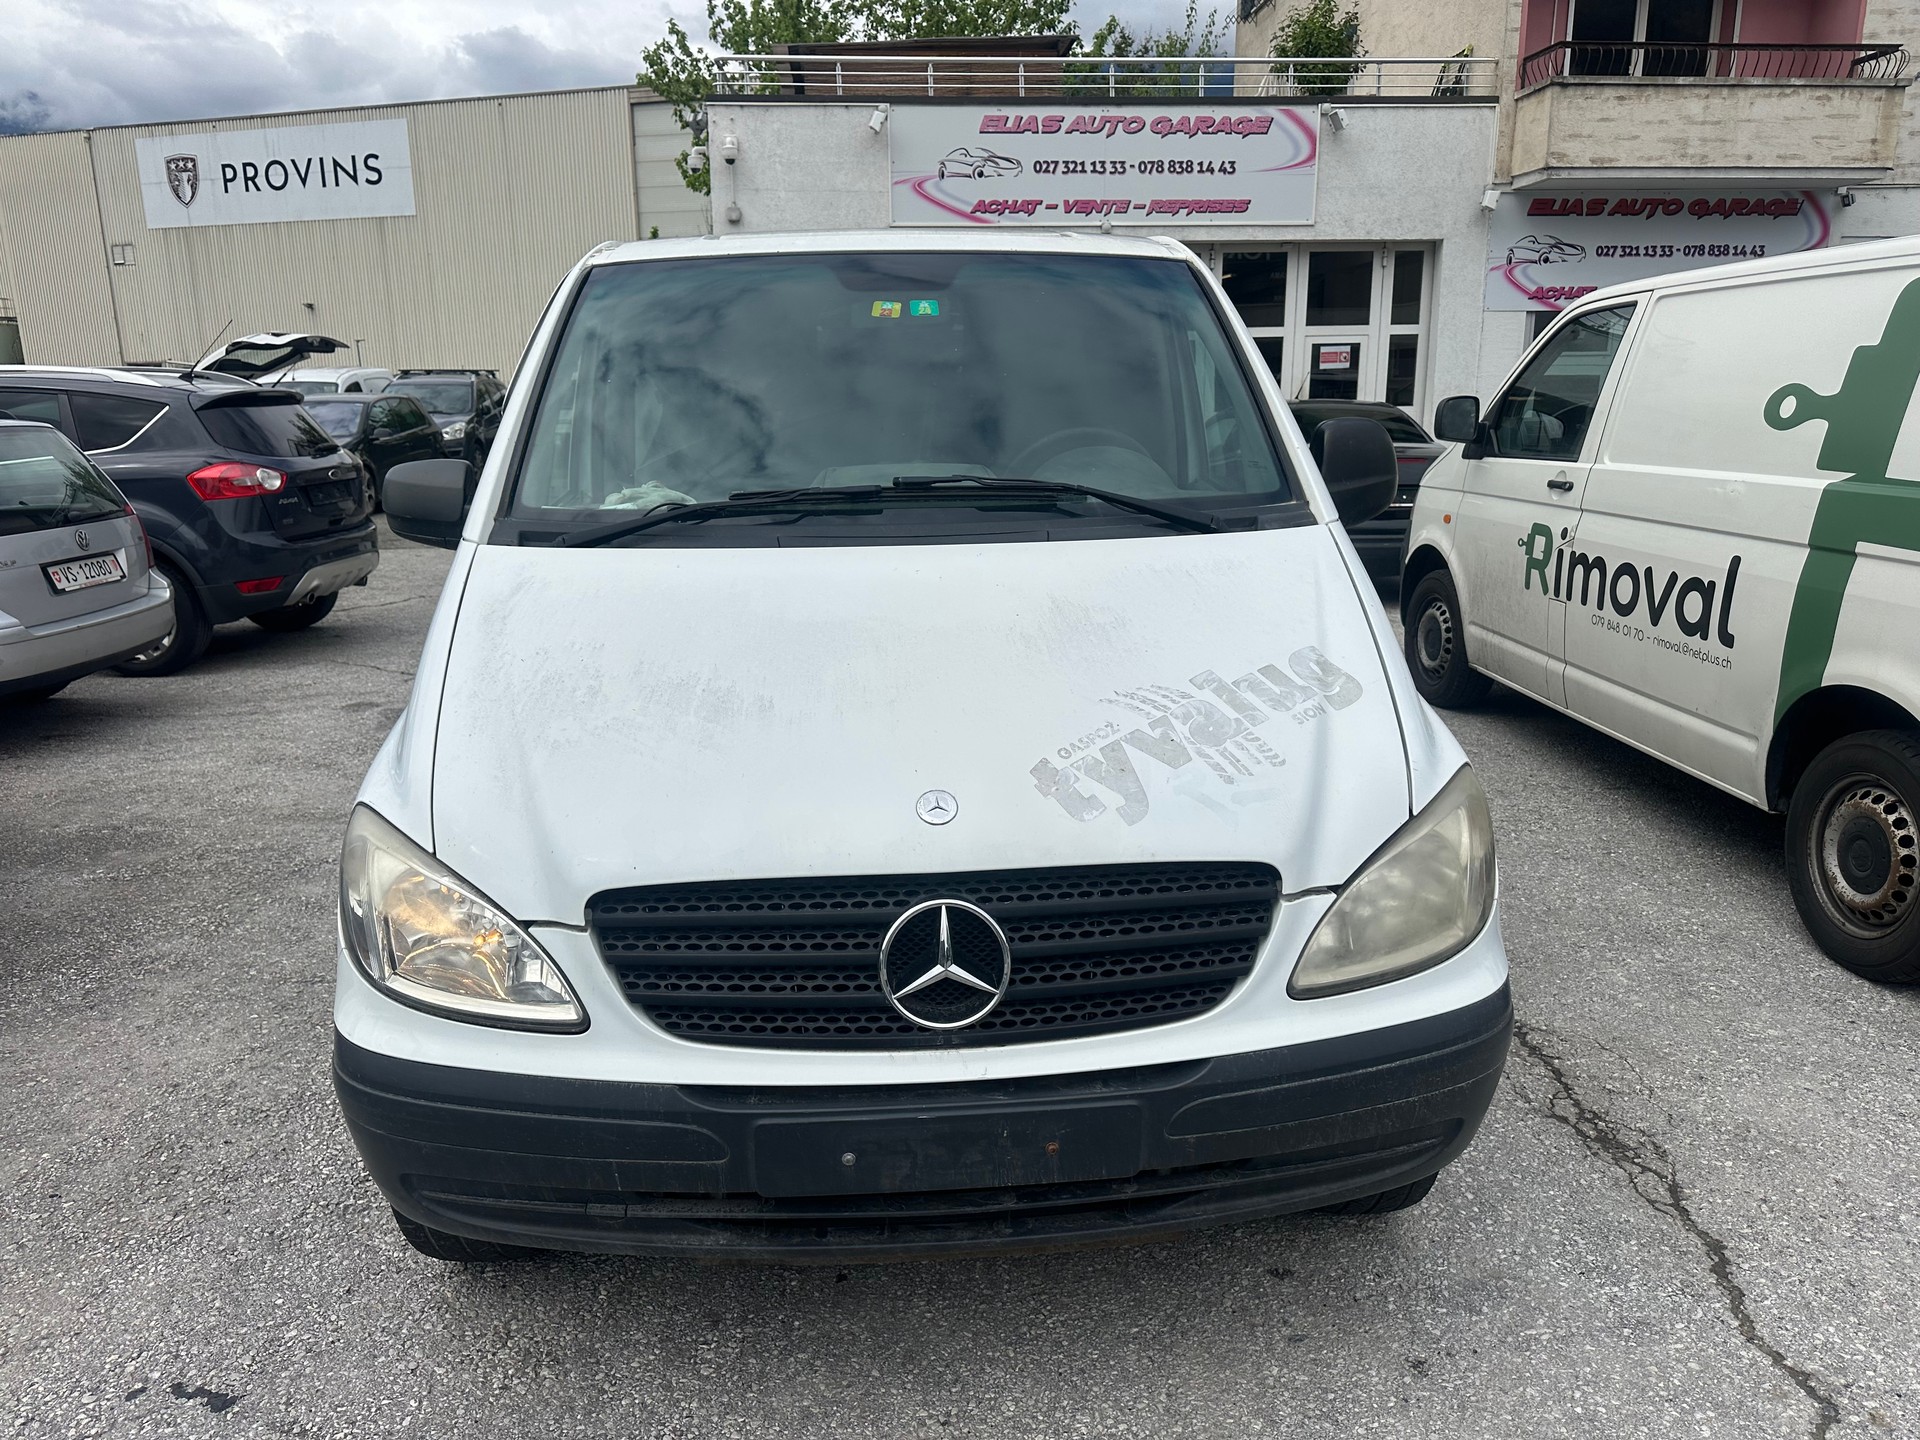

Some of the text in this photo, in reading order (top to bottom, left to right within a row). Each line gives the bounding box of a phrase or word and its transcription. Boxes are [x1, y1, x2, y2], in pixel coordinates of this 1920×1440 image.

[979, 114, 1274, 139] ELIAS AUTO GARAGE
[220, 153, 383, 194] PROVINS
[1033, 160, 1059, 175] 027
[1061, 160, 1087, 175] 321
[1090, 160, 1106, 175] 13
[1109, 160, 1126, 175] 33
[1138, 160, 1164, 175] 078
[1167, 160, 1194, 175] 838
[1197, 160, 1215, 175] 14
[1218, 160, 1236, 175] 43
[970, 199, 1043, 217] ACHAT
[1063, 199, 1130, 217] VENTE
[1146, 199, 1251, 217] REPRISES
[1527, 197, 1804, 220] ELIAS AUTO GARAGE
[1596, 245, 1618, 258] 027
[1619, 245, 1641, 258] 321
[1643, 245, 1658, 258] 13
[1659, 245, 1674, 258] 33
[1682, 244, 1706, 258] 078
[1707, 244, 1730, 257] 838
[1732, 245, 1747, 258] 14
[1749, 244, 1766, 257] 43
[1518, 522, 1742, 649] Rimoval
[1591, 614, 1605, 628] 079
[1607, 619, 1620, 633] 848
[1622, 624, 1632, 637] 01
[1633, 628, 1644, 641] 70
[1653, 635, 1732, 670] rimoval@netplus.ch
[1291, 702, 1327, 725] SION
[1029, 646, 1363, 826] tyvalug
[1057, 720, 1120, 759] GASPOZ
